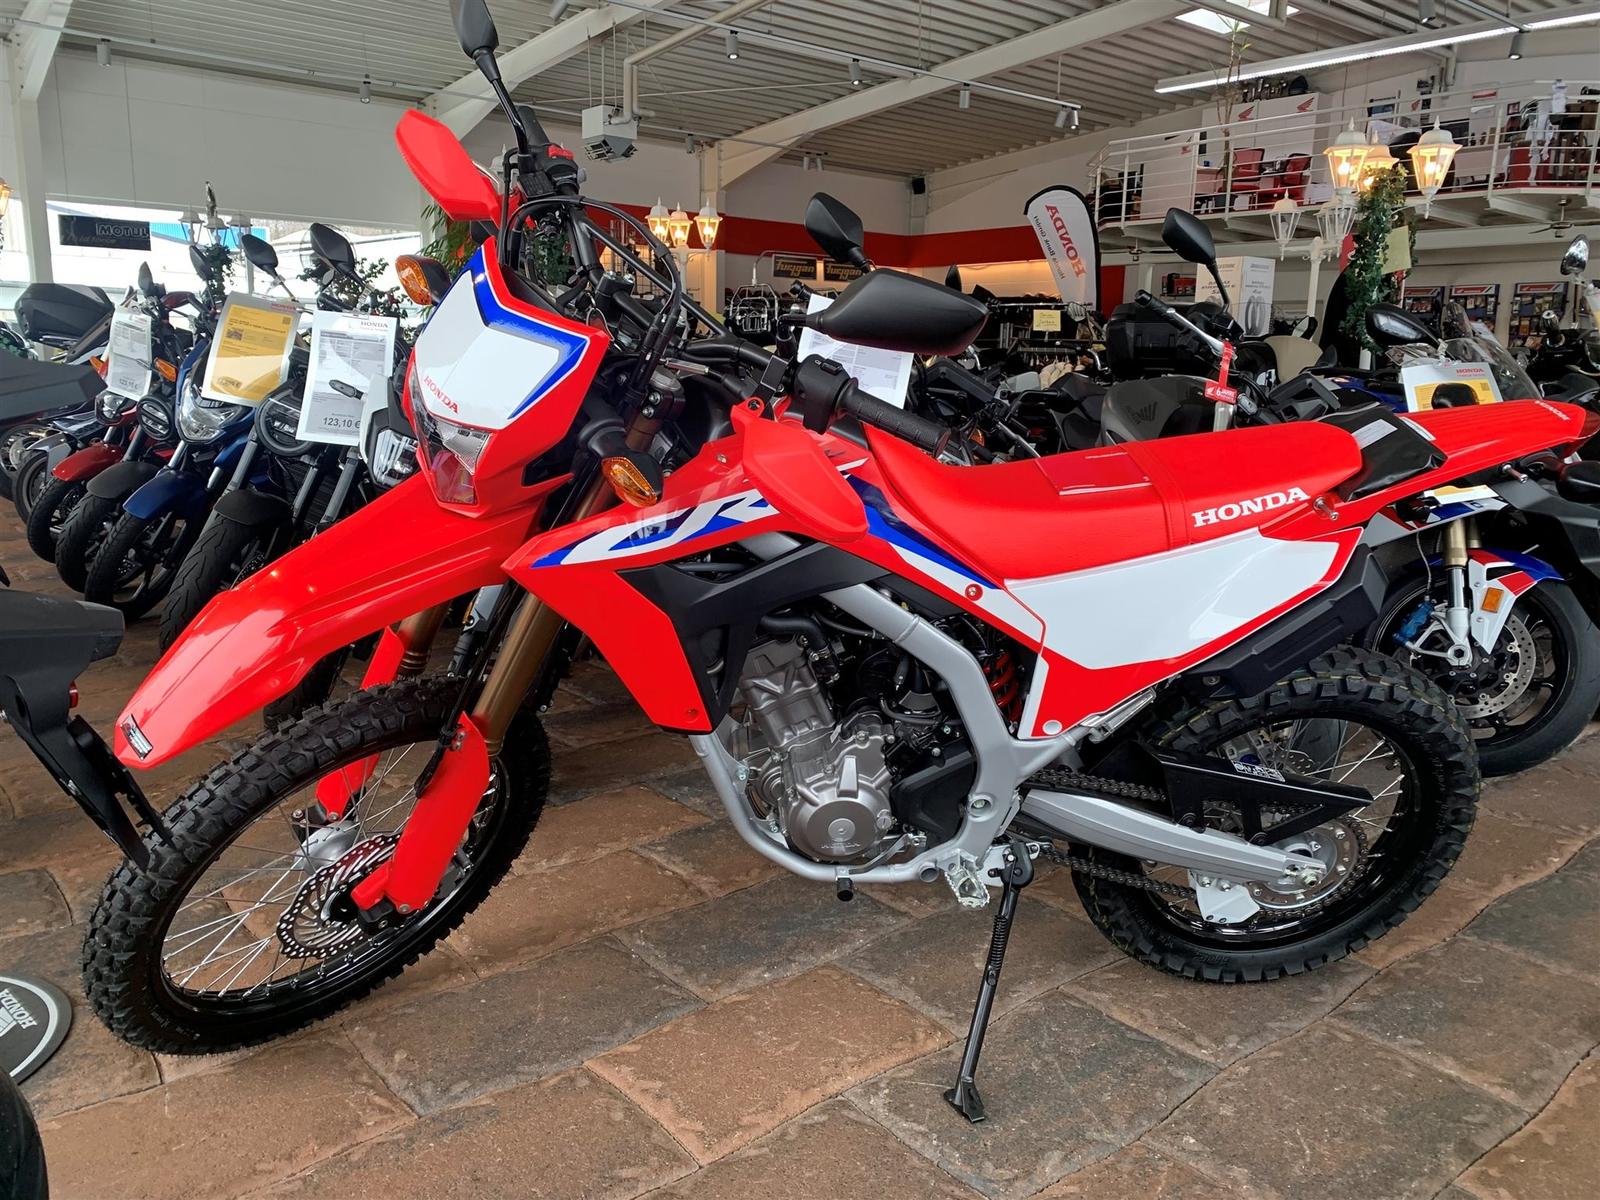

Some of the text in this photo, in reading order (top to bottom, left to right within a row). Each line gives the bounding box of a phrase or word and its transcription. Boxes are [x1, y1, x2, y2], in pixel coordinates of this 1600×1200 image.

[99, 224, 149, 236] MOTUL
[424, 376, 459, 414] HONDA
[323, 417, 353, 428] 123,10
[1191, 486, 1311, 528] HONDA
